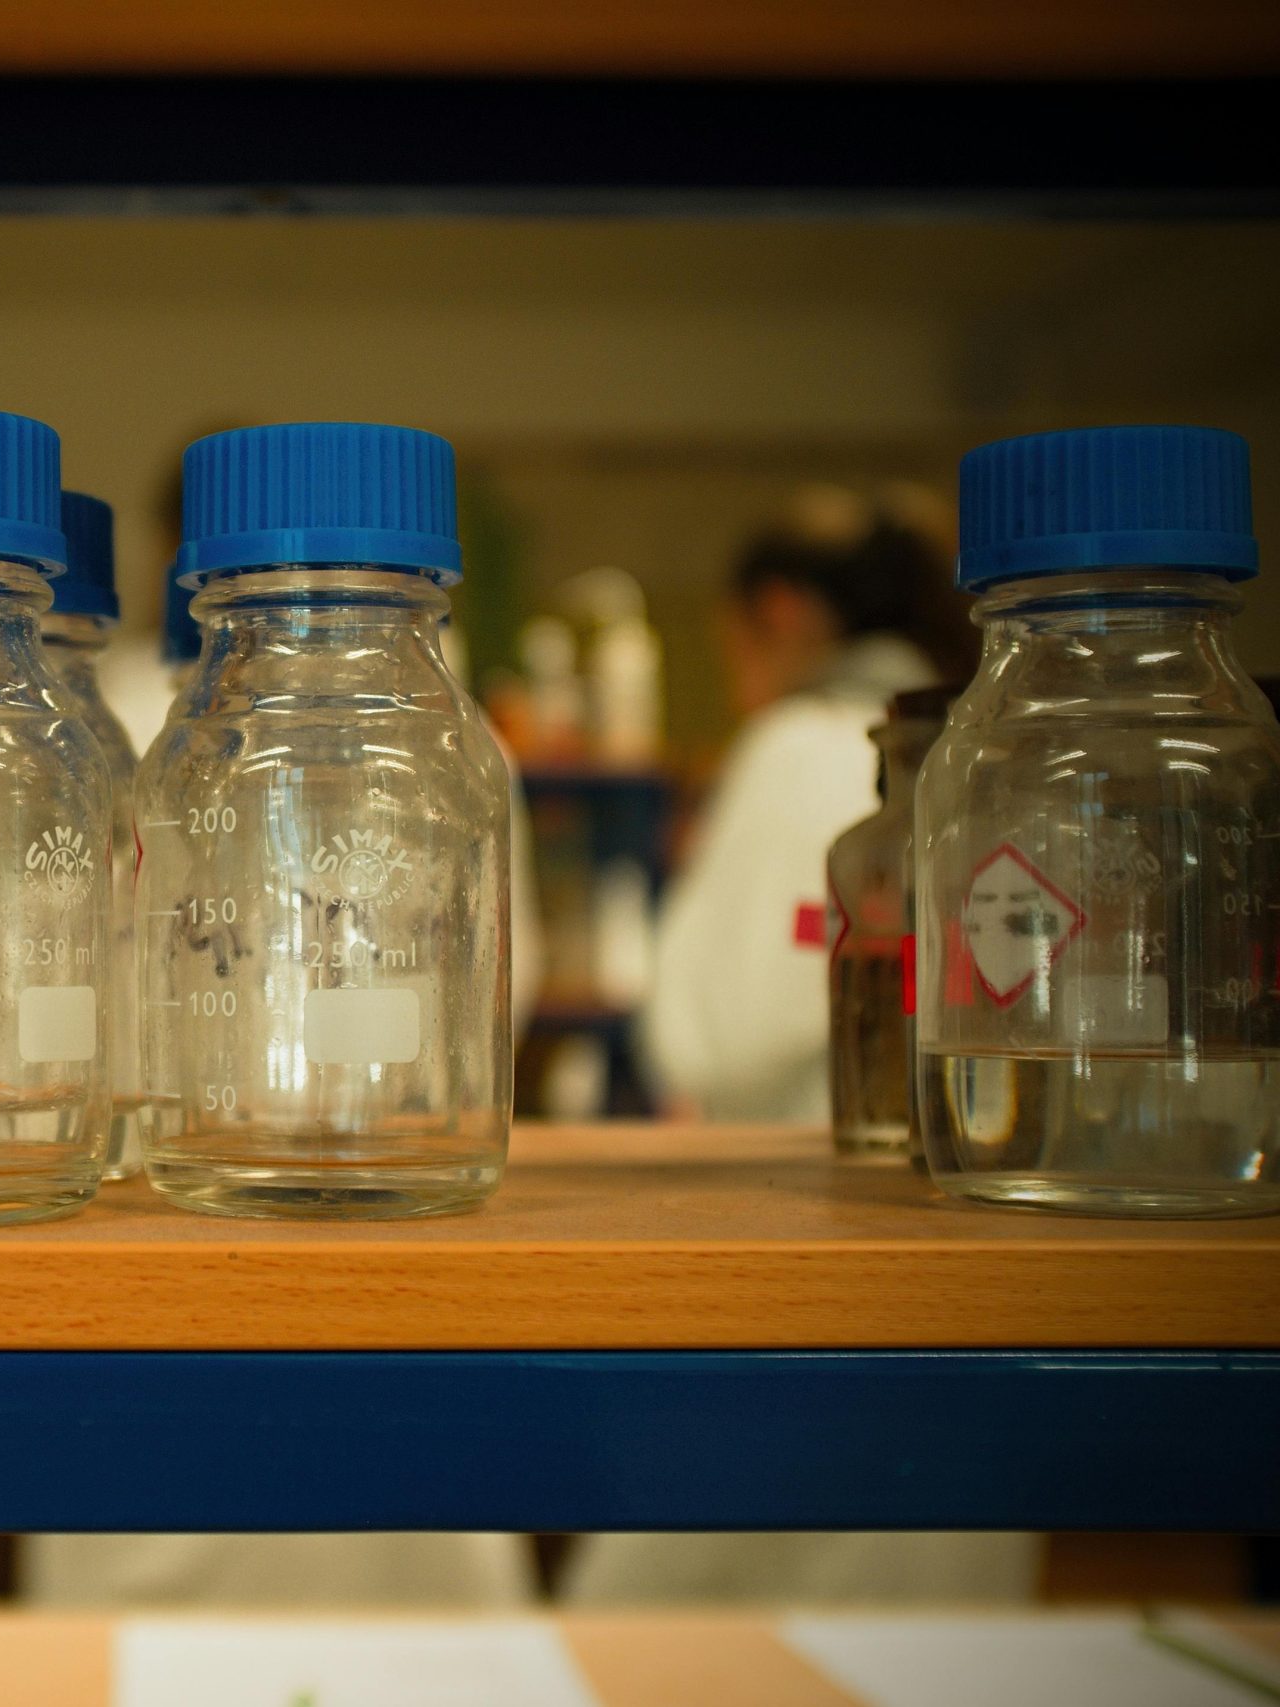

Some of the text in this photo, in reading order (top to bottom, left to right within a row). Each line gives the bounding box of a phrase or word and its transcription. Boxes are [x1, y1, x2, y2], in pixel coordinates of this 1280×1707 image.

[188, 807, 237, 834] 200
[25, 826, 94, 871] SIMAX
[311, 829, 413, 874] SIMAX
[357, 872, 415, 912] REPUBLIC
[188, 898, 237, 924] 150
[23, 938, 96, 965] 250 ml
[308, 942, 417, 968] 250 ml
[189, 991, 237, 1017] 100
[206, 1085, 237, 1111] 50
